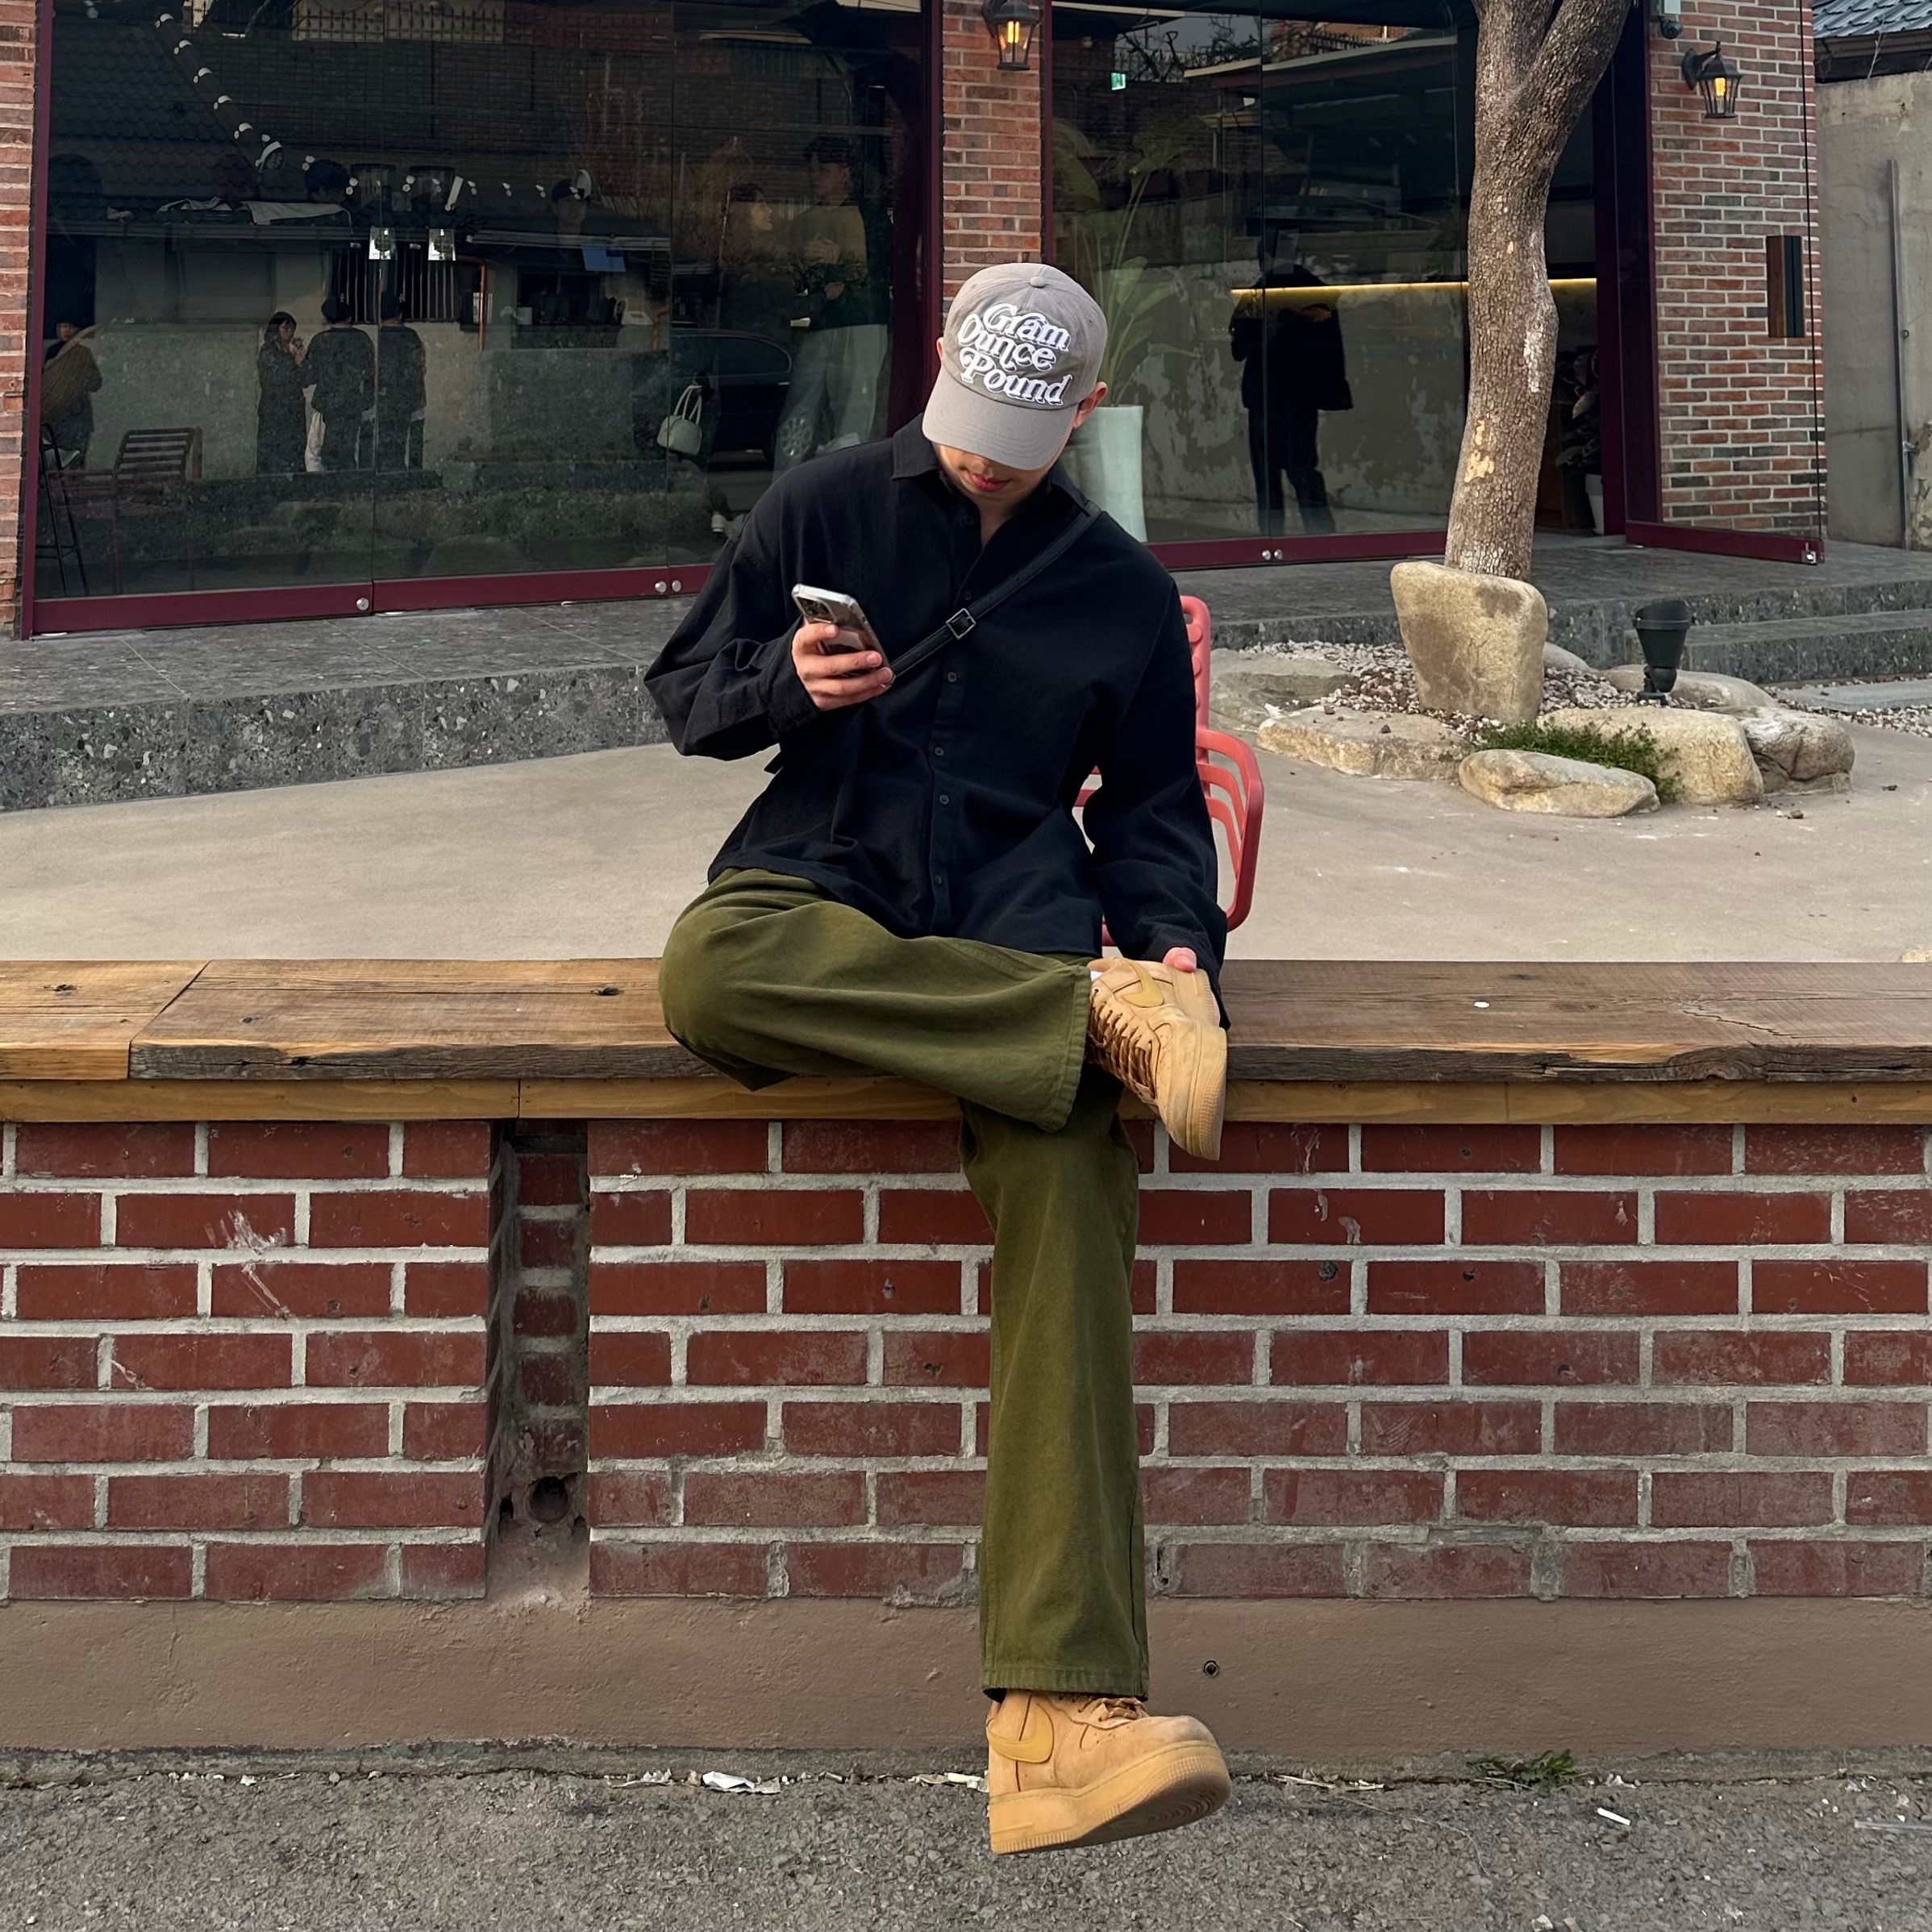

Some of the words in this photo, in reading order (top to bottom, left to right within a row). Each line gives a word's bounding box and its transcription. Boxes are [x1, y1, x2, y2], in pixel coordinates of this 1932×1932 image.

[958, 314, 1056, 372] Ounce
[983, 303, 1071, 352] Gram
[960, 348, 1072, 406] Pound
